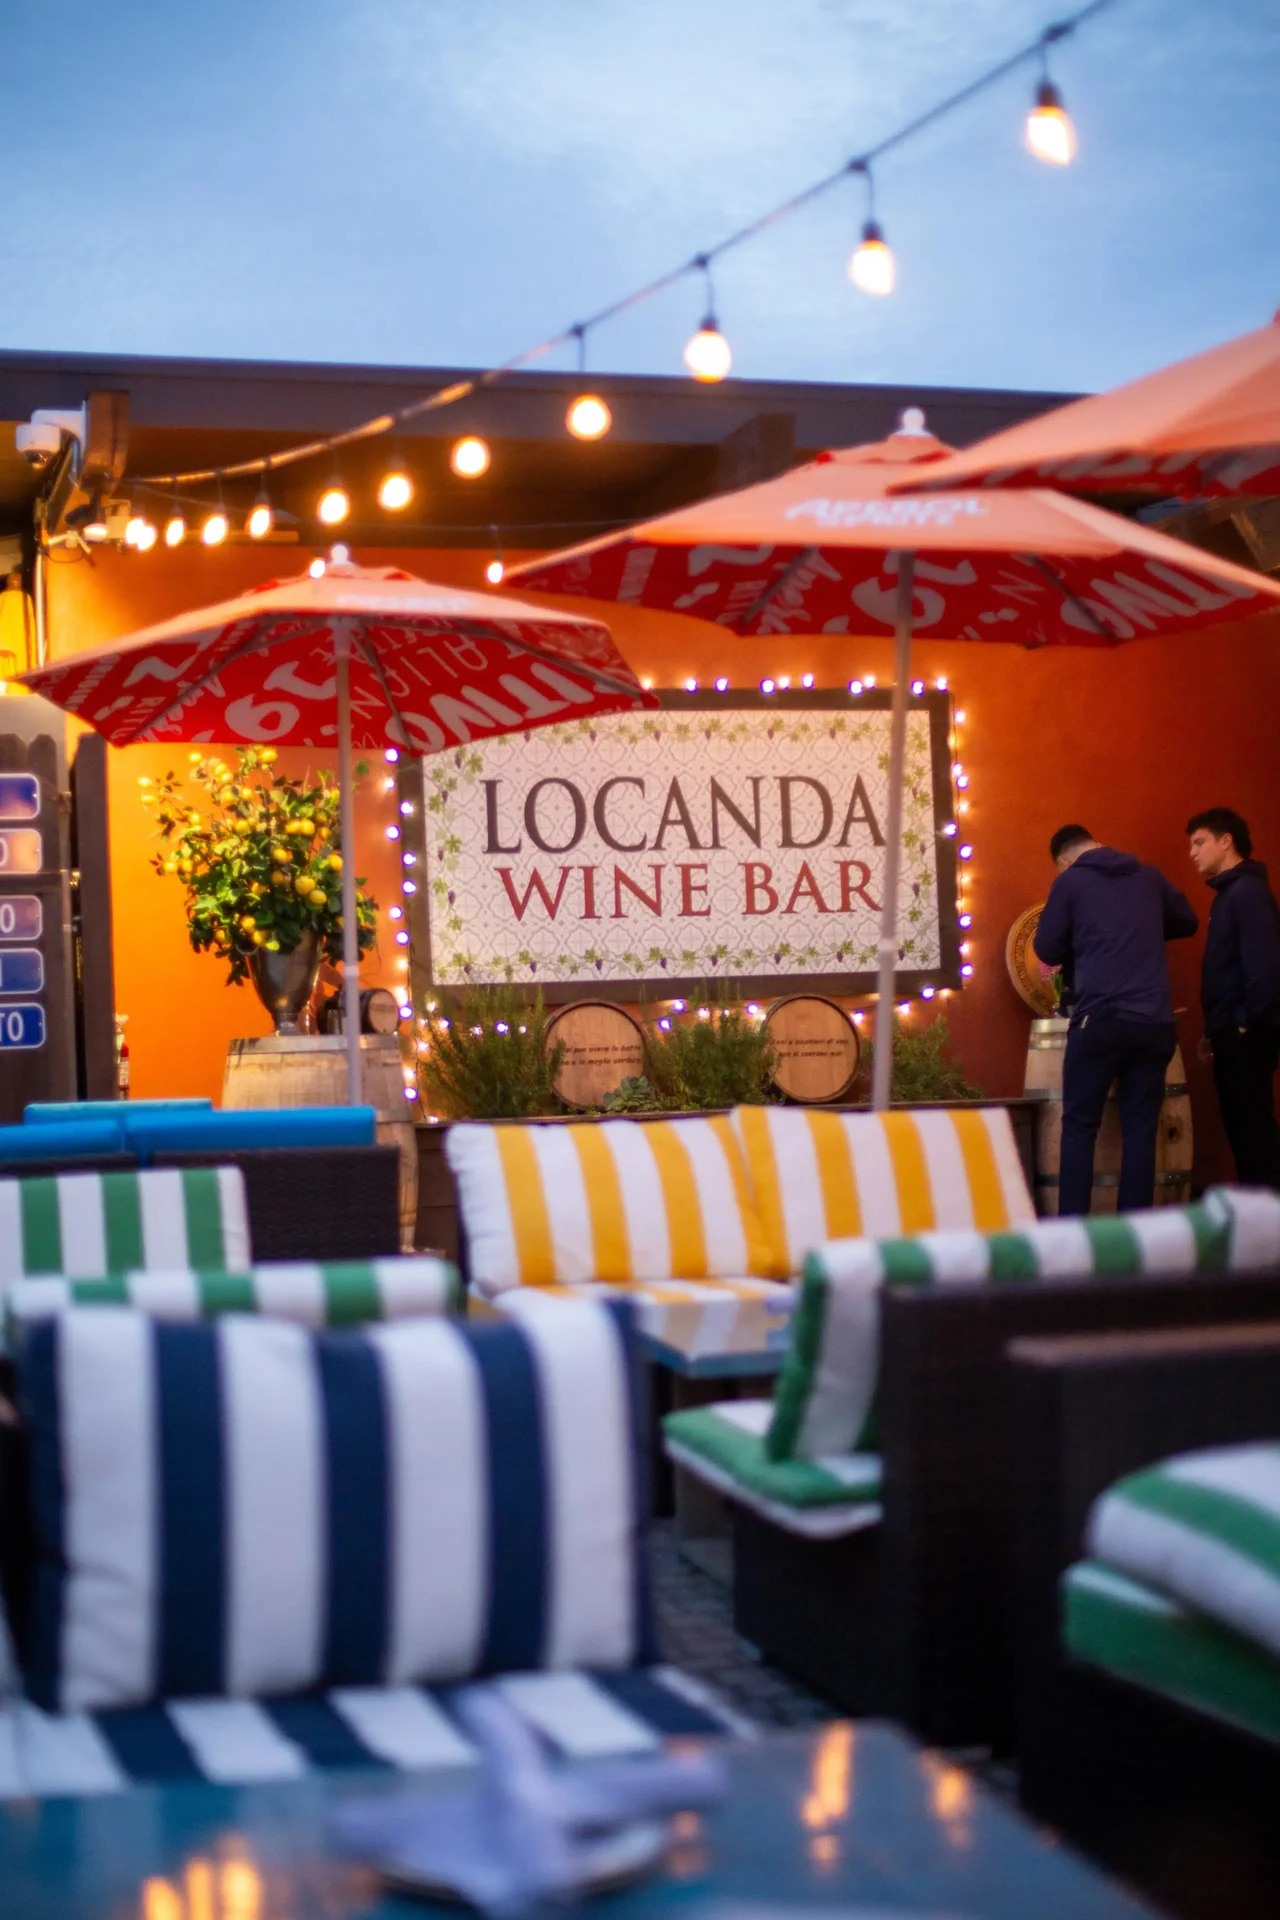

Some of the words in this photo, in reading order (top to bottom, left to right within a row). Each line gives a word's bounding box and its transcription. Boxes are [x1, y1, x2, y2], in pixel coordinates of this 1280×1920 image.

[481, 773, 886, 854] LOCANDA
[494, 862, 712, 922] WINE
[738, 859, 883, 916] BAR
